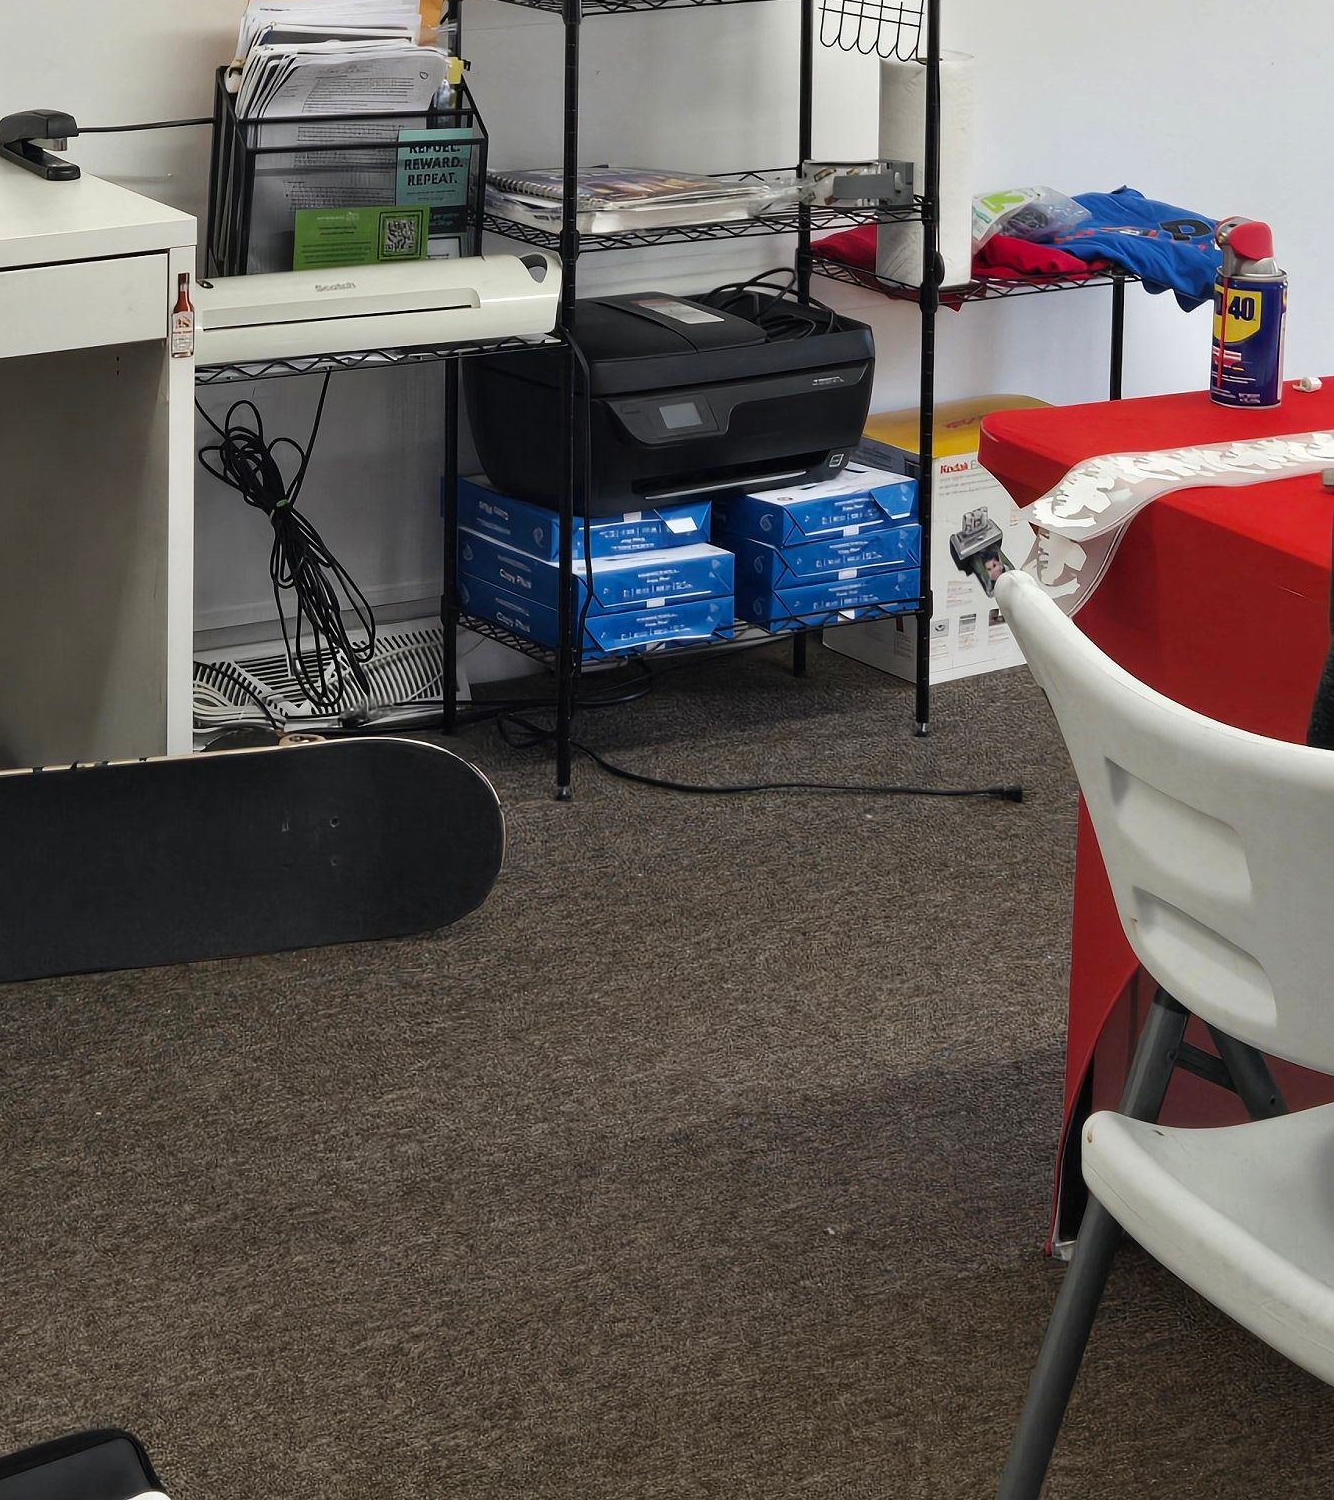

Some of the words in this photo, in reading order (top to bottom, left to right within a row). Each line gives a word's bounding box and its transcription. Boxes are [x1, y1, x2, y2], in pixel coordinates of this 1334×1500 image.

[404, 157, 463, 170] REWARD.
[407, 172, 457, 186] REPEAT.
[940, 462, 968, 474] Kodak
